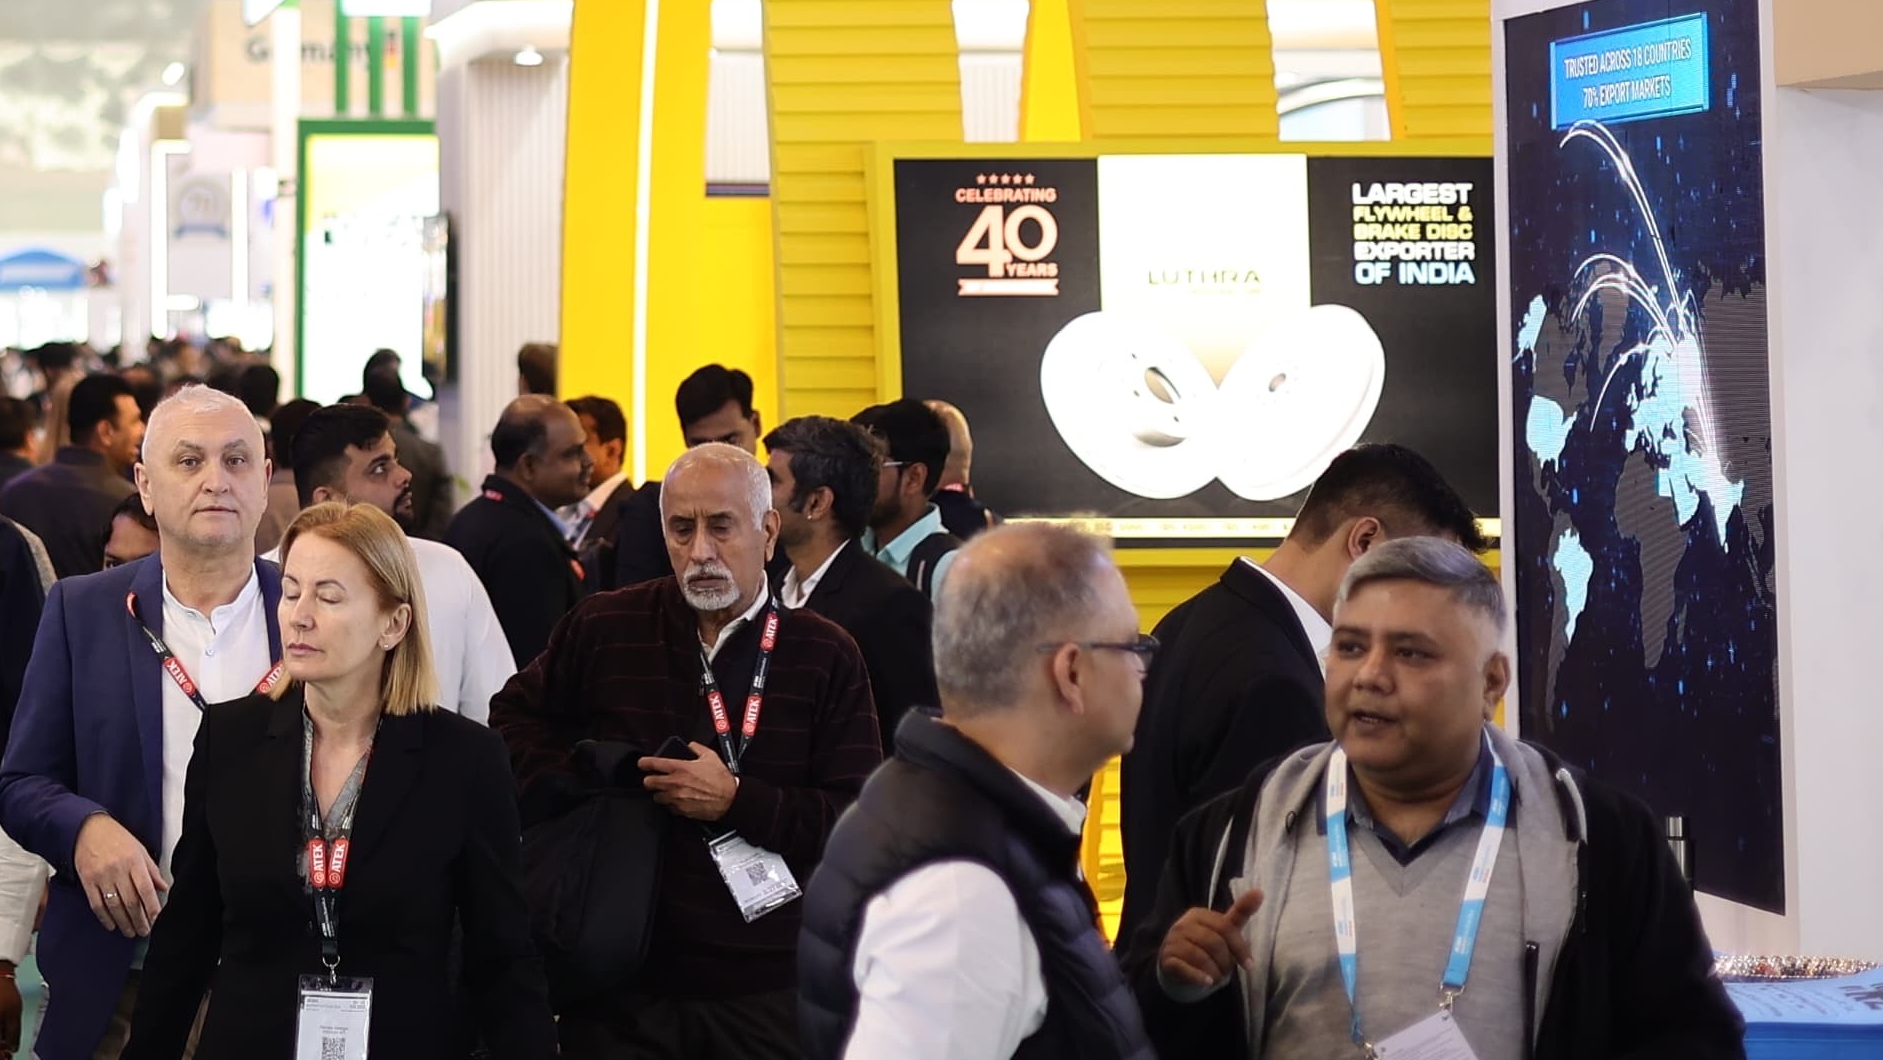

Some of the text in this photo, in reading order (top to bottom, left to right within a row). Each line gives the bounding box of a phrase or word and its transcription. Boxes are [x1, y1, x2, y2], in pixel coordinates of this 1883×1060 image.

[1563, 38, 1693, 79] TRUSTED ACROSS 18 COUNTRIES
[1583, 74, 1672, 108] 70% EXPORT MARKETS
[955, 187, 1058, 203] CELEBRATING
[1351, 182, 1473, 205] LARGEST
[1353, 205, 1474, 222] FLYWHEEL &
[955, 204, 1058, 278] 40
[1353, 222, 1474, 240] BRAKE DISC
[1354, 240, 1476, 261] EXPORTER
[1005, 262, 1059, 277] YEARS
[1354, 261, 1476, 285] OF INDIA
[166, 660, 188, 688] ATEK
[746, 698, 761, 724] ATEK
[312, 843, 324, 872] ATEK
[331, 842, 346, 873] ATEK
